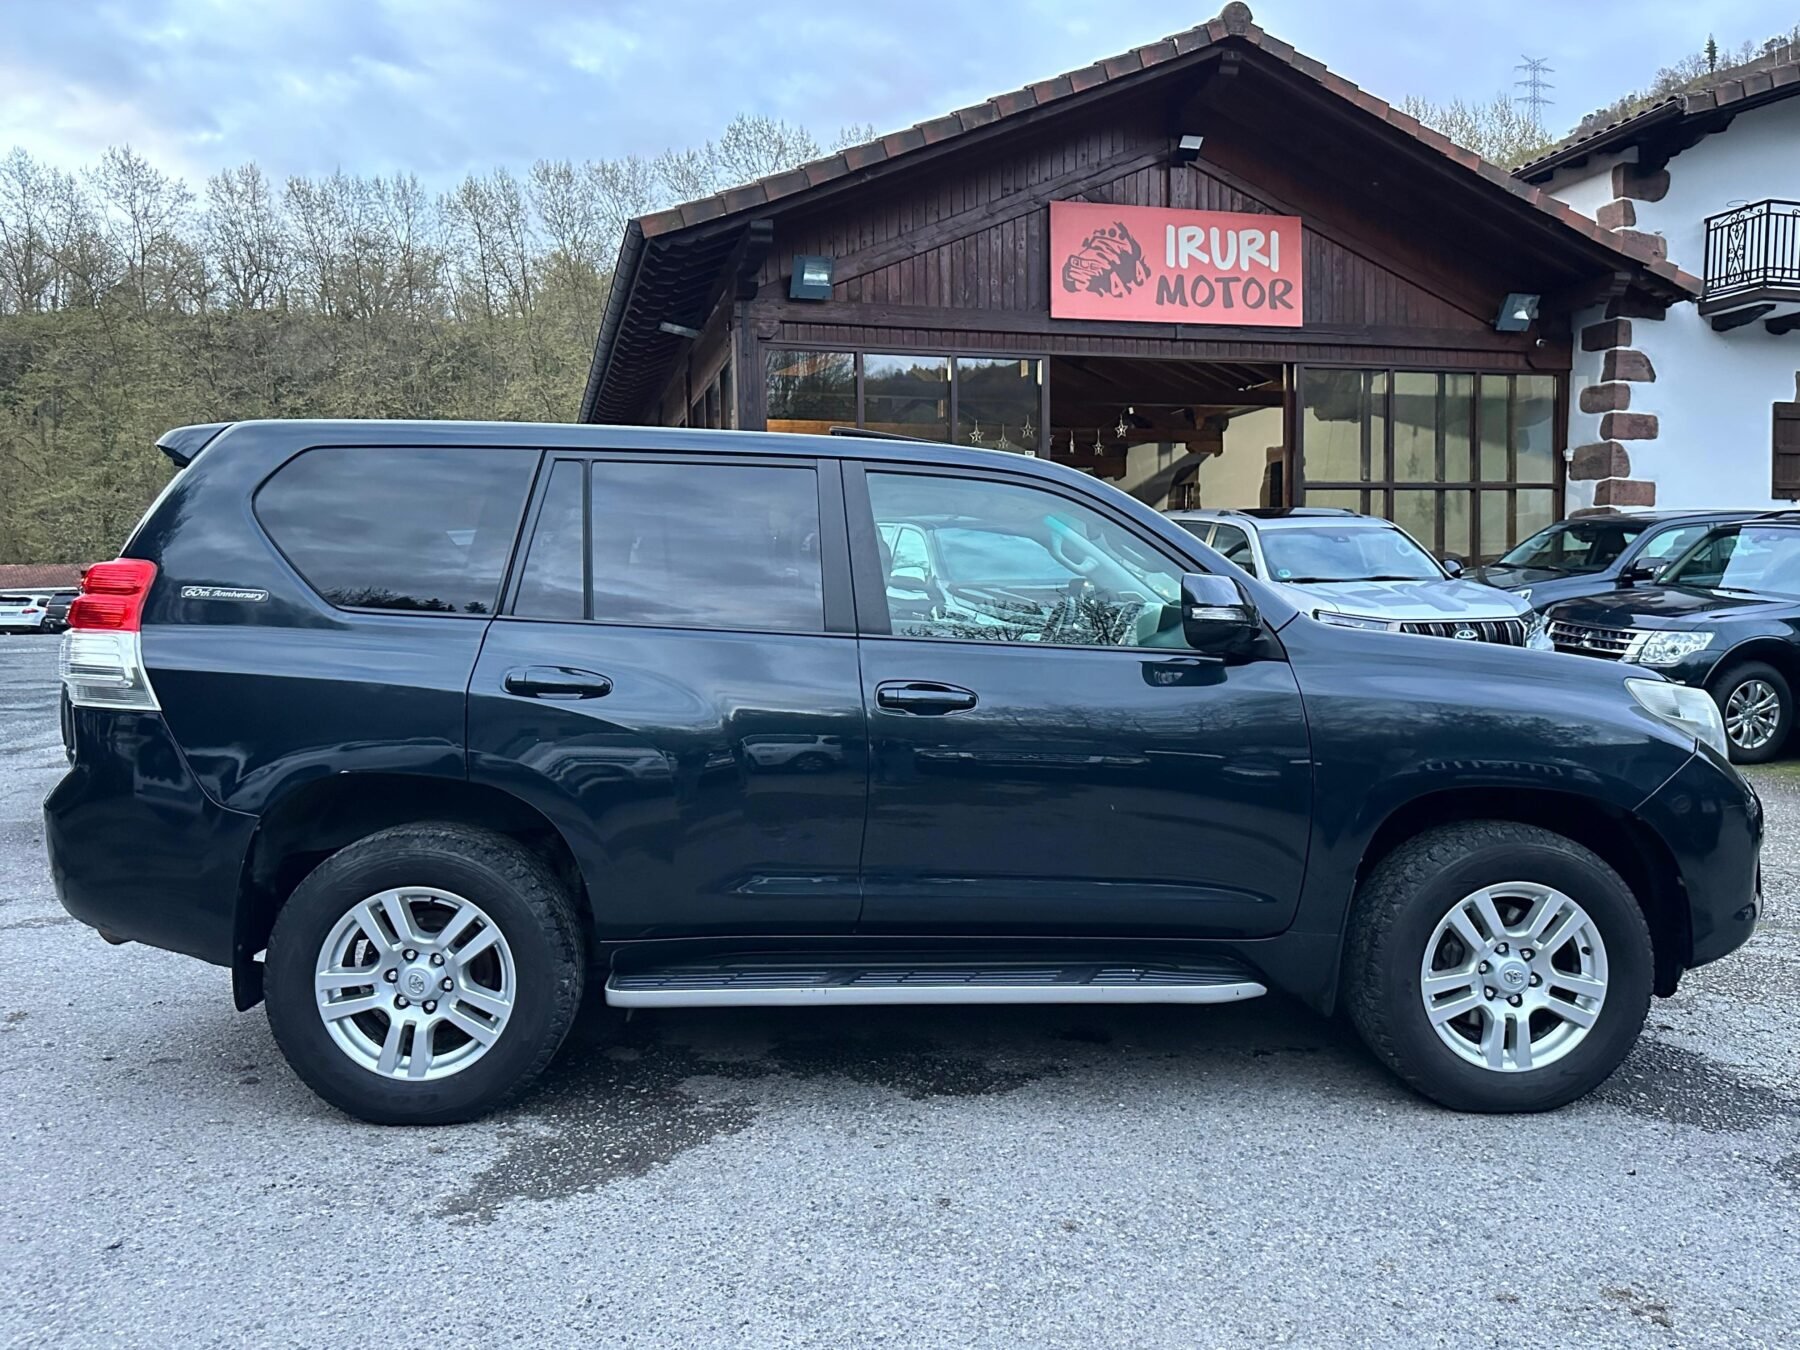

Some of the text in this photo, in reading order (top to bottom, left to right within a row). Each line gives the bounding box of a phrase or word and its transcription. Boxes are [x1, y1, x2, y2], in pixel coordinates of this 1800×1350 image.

[1165, 224, 1279, 273] IRURI
[1156, 274, 1294, 310] MOTOR
[184, 588, 265, 601] 60th Anniversary
